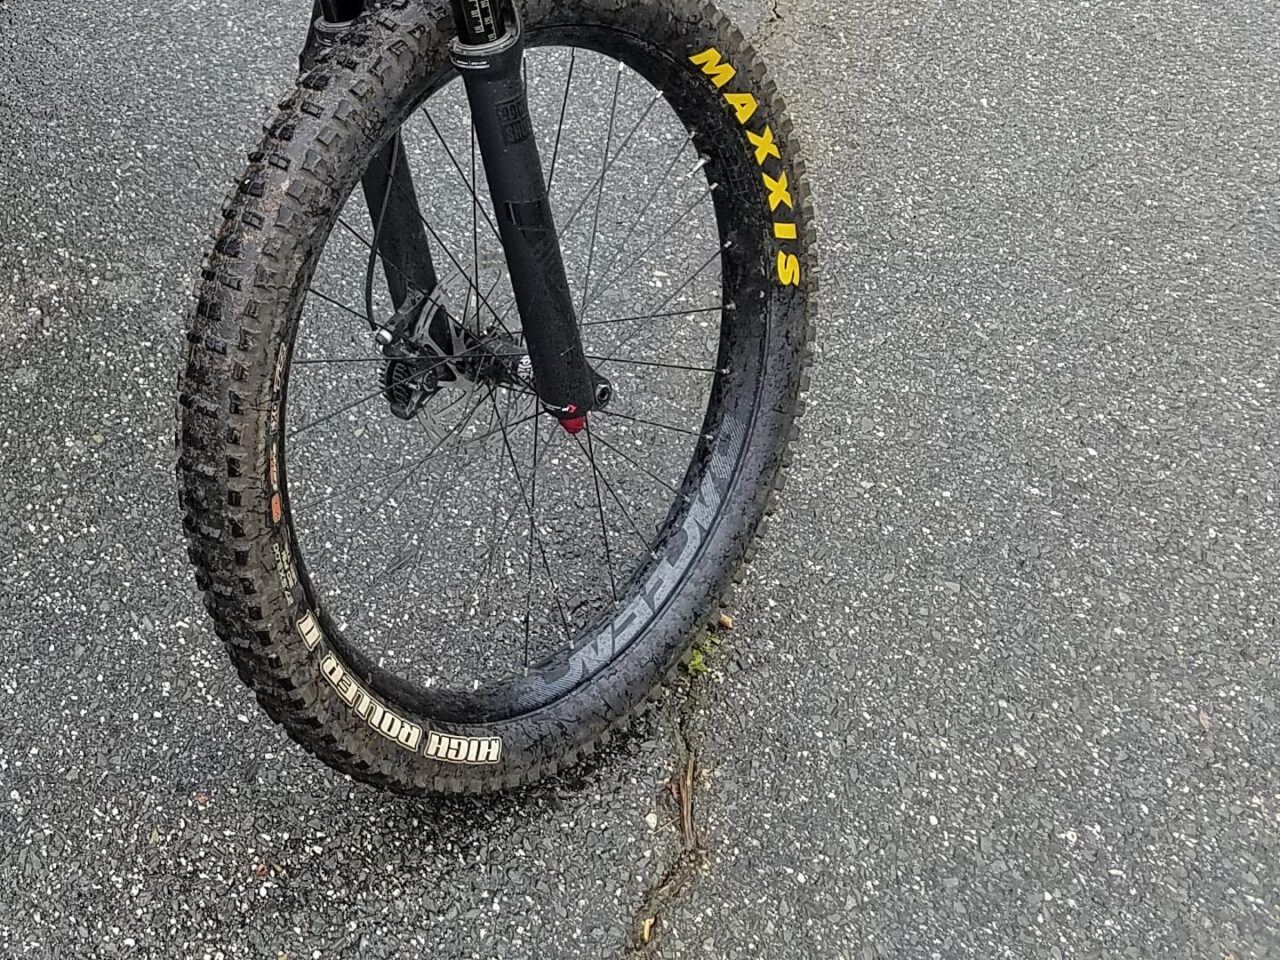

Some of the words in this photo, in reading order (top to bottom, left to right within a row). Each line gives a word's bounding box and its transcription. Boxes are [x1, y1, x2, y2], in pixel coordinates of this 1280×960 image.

[688, 47, 800, 287] MAXXIS
[320, 650, 422, 752] ROLLER
[424, 731, 502, 765] HIGH
